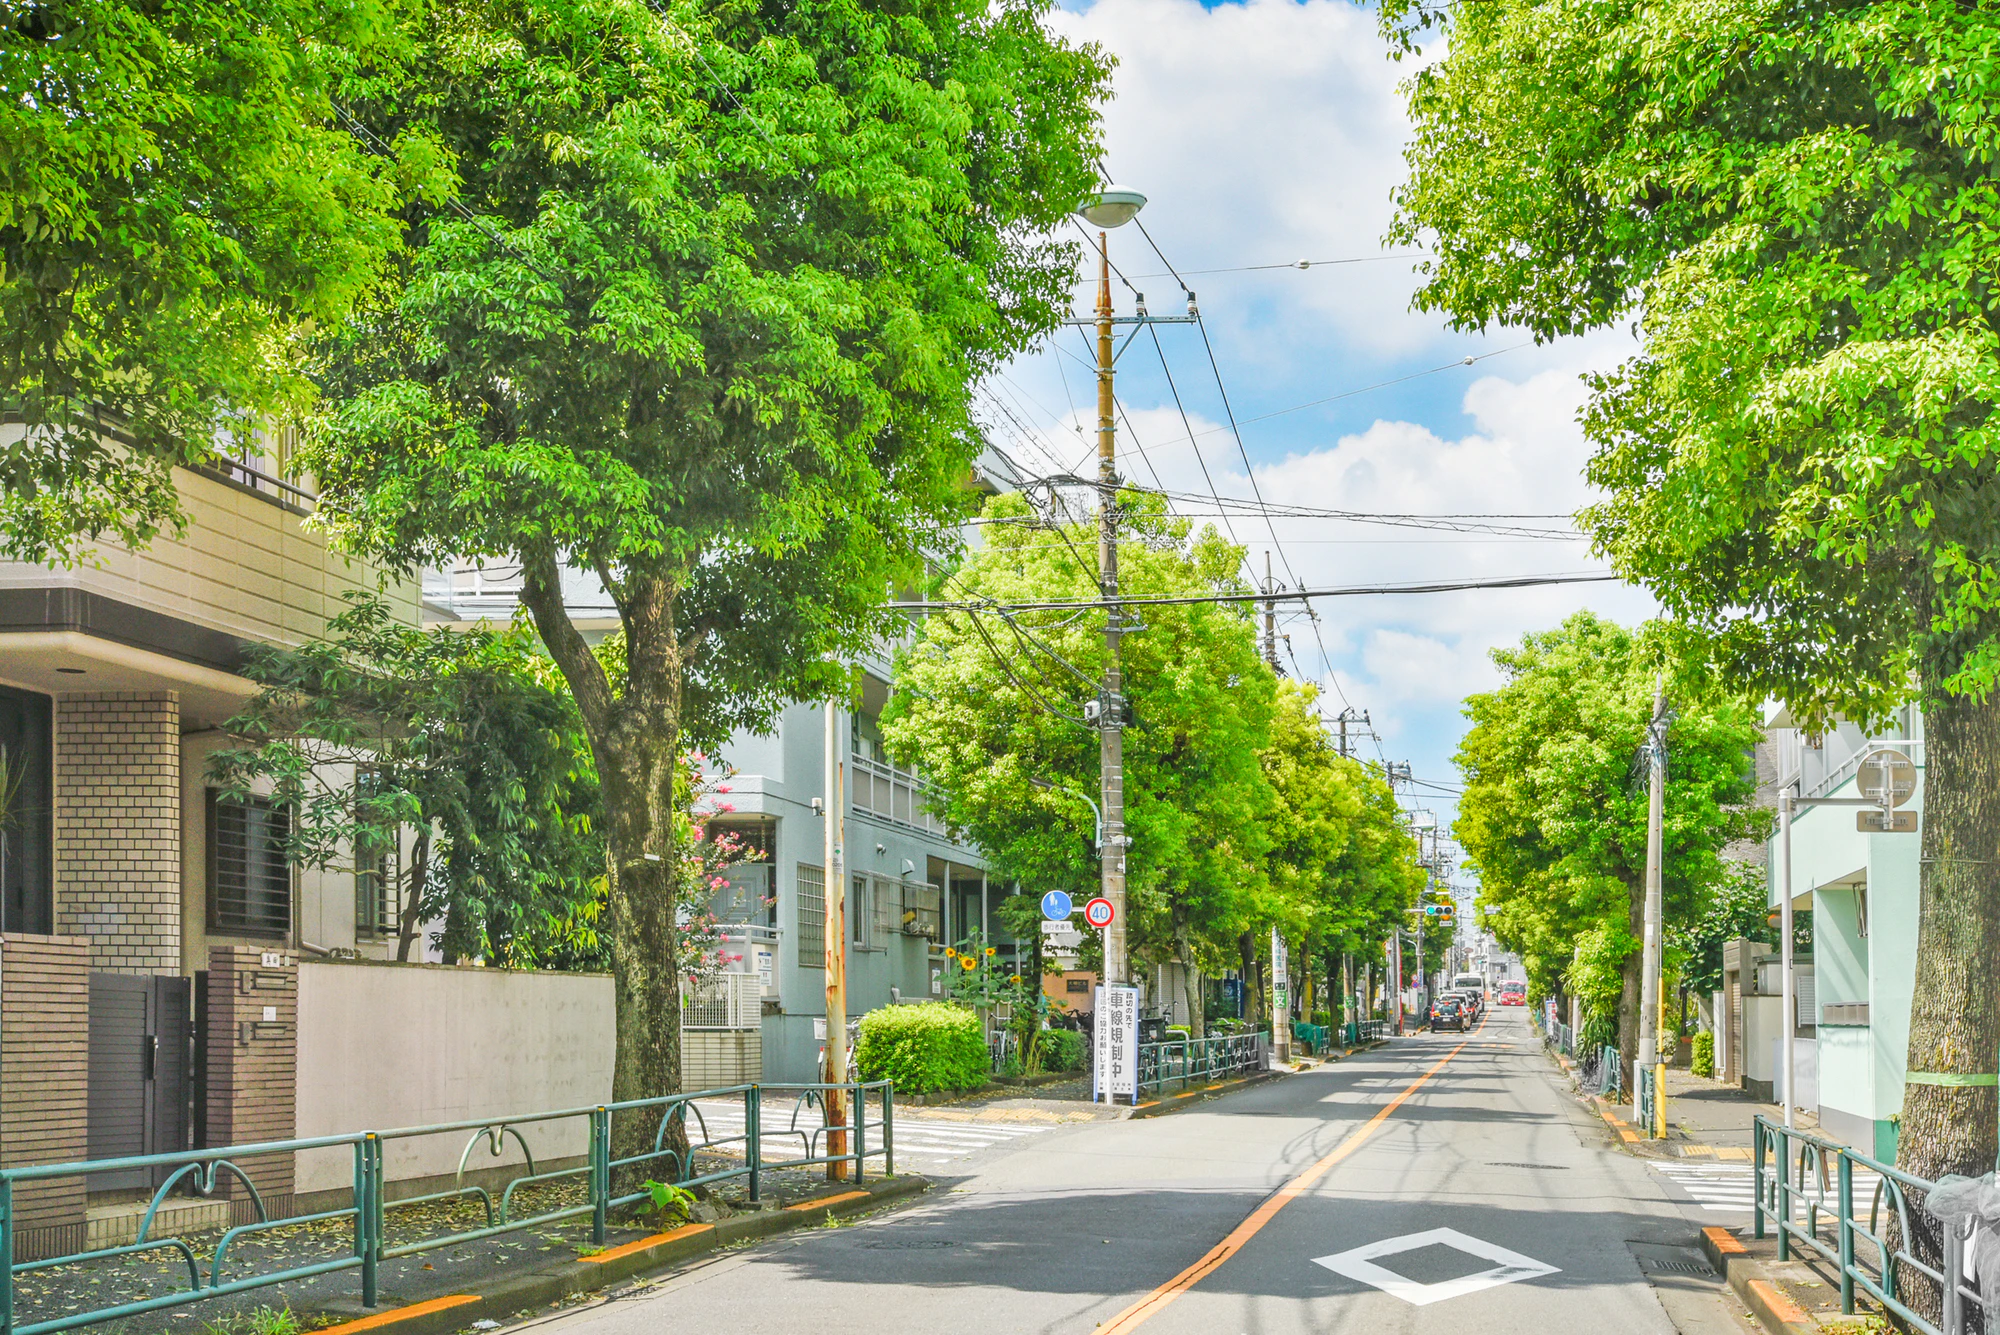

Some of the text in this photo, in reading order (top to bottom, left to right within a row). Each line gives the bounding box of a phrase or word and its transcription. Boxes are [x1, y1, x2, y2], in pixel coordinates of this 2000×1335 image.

[1092, 906, 1109, 919] 40
[1110, 991, 1124, 1079] 車線規制中
